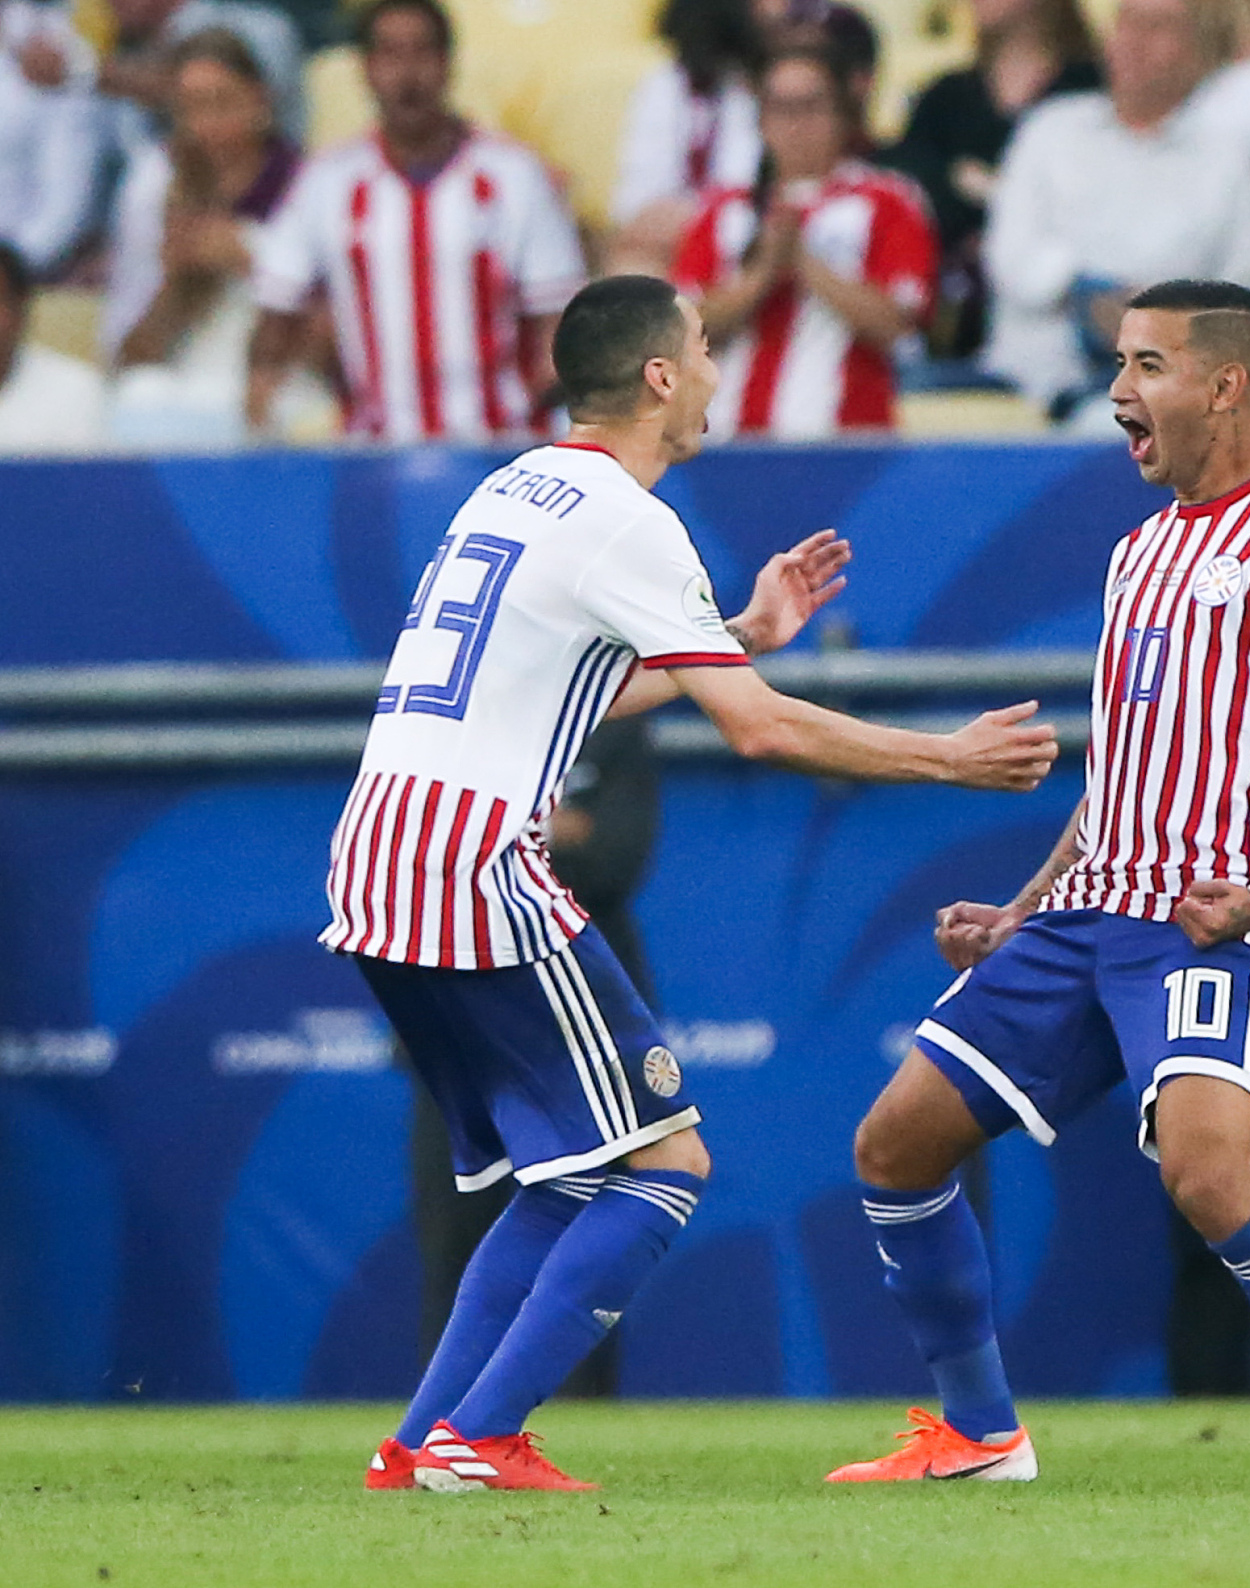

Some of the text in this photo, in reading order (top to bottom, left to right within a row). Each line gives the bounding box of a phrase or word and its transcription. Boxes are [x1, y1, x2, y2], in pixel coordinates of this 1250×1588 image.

[374, 533, 526, 721] 23
[1121, 626, 1171, 703] 10
[1163, 967, 1234, 1042] 10
